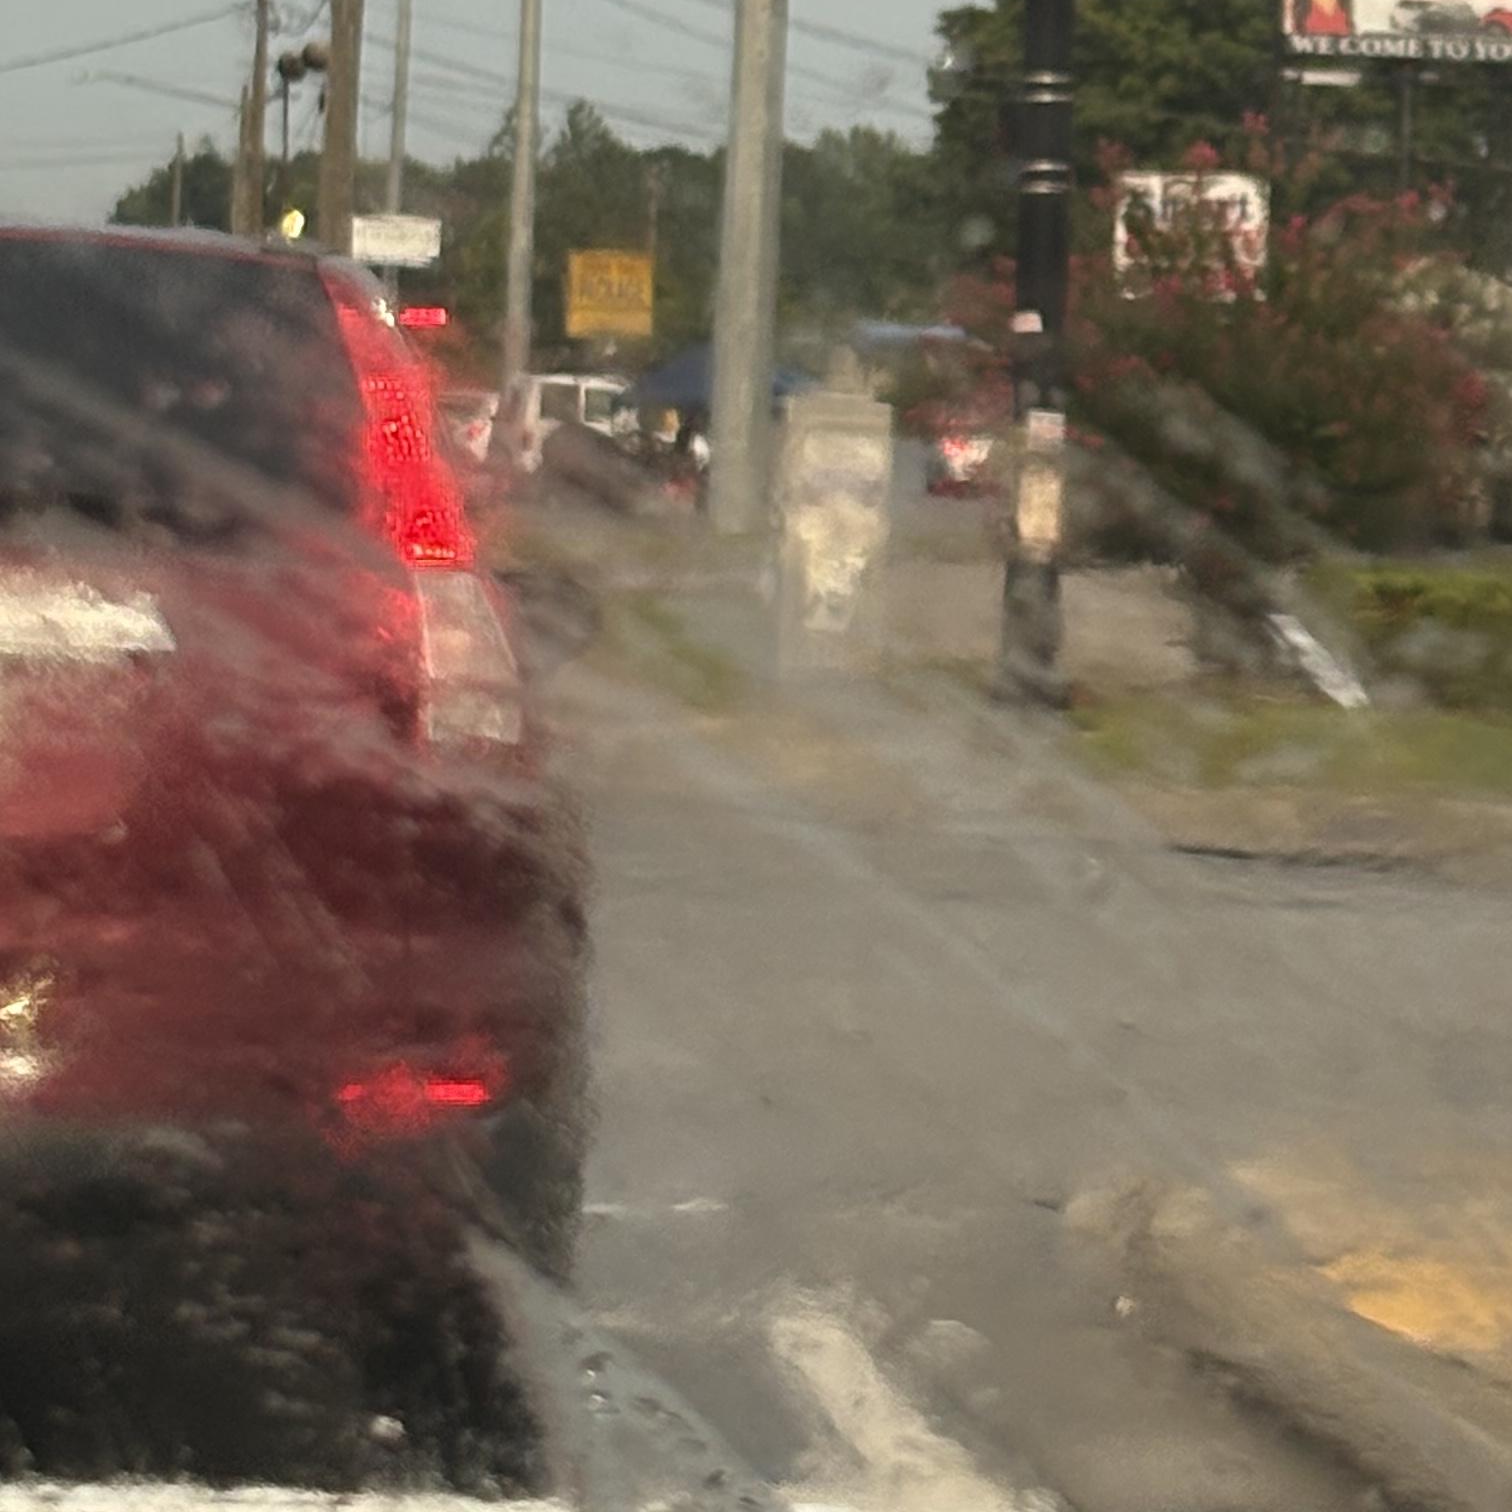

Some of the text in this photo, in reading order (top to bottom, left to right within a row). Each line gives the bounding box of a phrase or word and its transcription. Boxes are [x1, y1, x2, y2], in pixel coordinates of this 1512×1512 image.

[1290, 37, 1333, 56] WE
[1338, 38, 1421, 58] COME
[1426, 41, 1470, 60] TO
